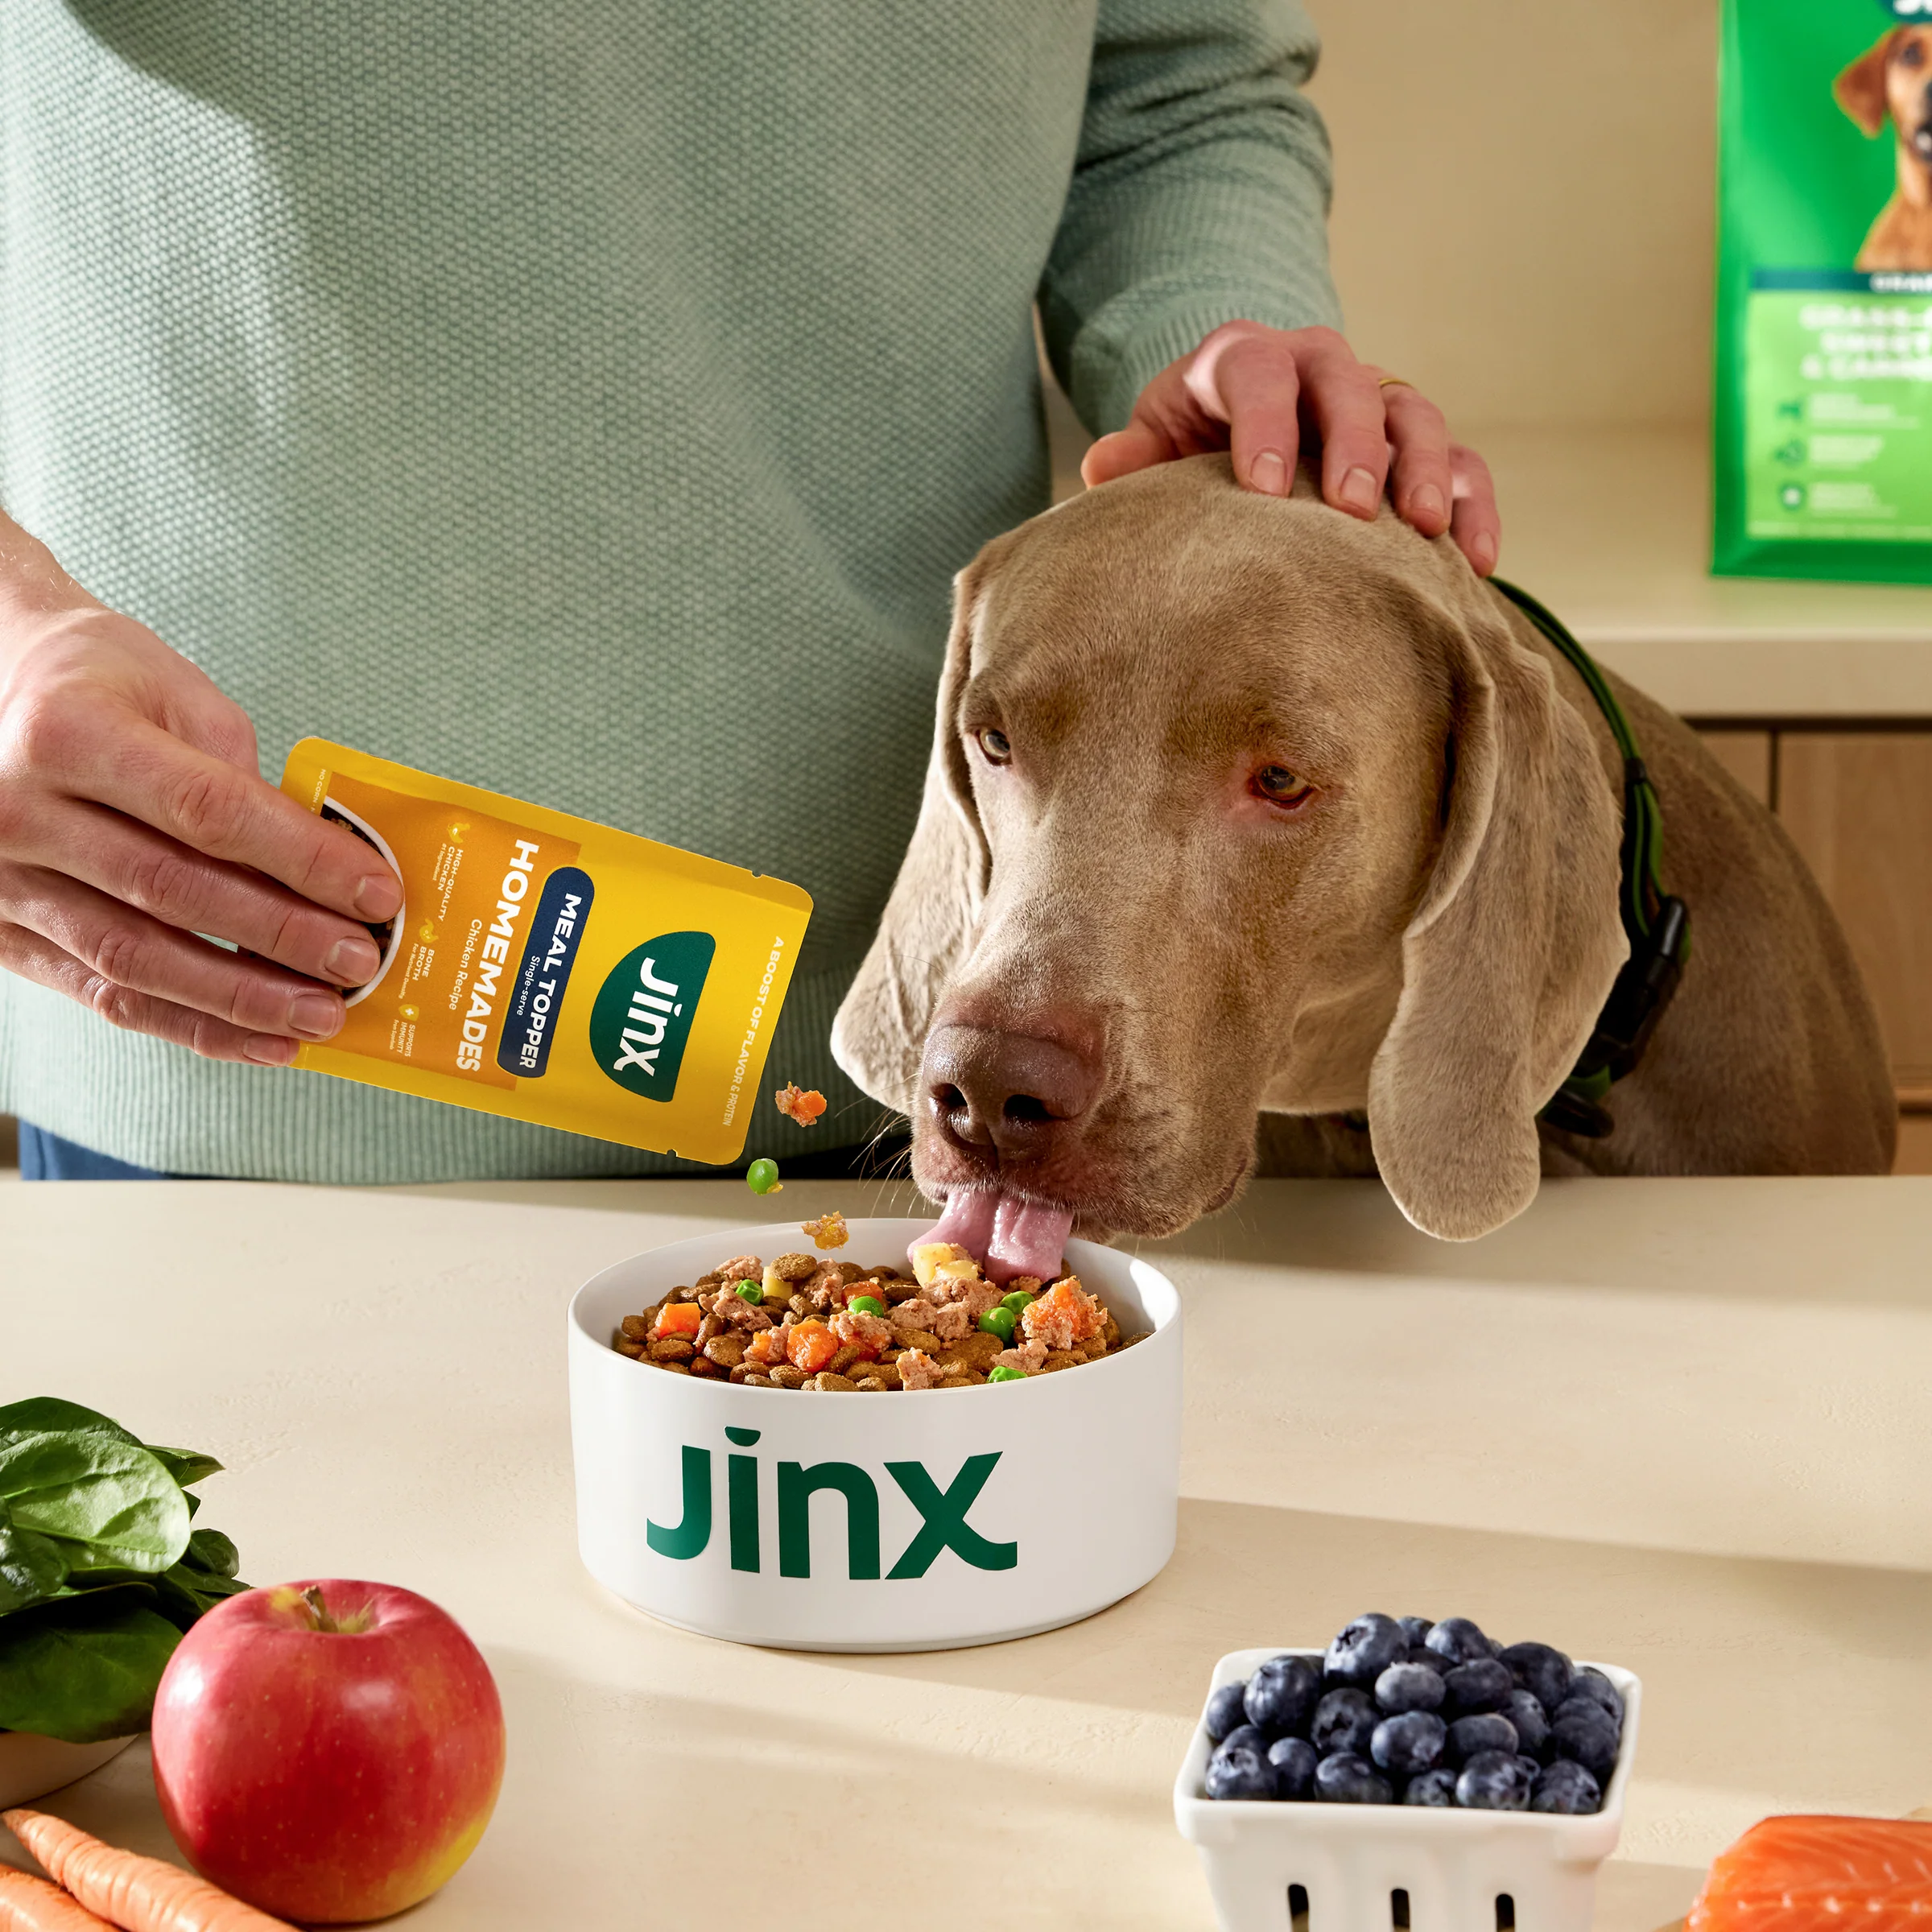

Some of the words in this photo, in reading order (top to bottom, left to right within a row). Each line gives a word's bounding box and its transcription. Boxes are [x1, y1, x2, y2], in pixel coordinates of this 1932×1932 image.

[312, 780, 323, 803] CORN
[319, 769, 326, 781] NO
[437, 846, 456, 891] CHICKEN
[438, 848, 464, 922] HIGH-QUALITY
[460, 919, 483, 968] Chicken
[543, 893, 582, 972] MEAL
[773, 935, 785, 947] A
[412, 946, 427, 981] BROTH
[422, 948, 436, 977] BONE
[456, 839, 539, 1071] HOMEMADES
[448, 970, 469, 1010] Recipe
[516, 955, 541, 1016] Single-serve
[757, 950, 781, 1005] BOOST
[518, 979, 555, 1069] TOPPER
[749, 1005, 762, 1030] OF
[396, 1022, 407, 1054] IMMUNITY
[404, 1024, 416, 1057] SUPPORTS
[733, 1030, 756, 1084] FLAVOR
[730, 1084, 741, 1092] &
[722, 1092, 738, 1126] PROTEIN
